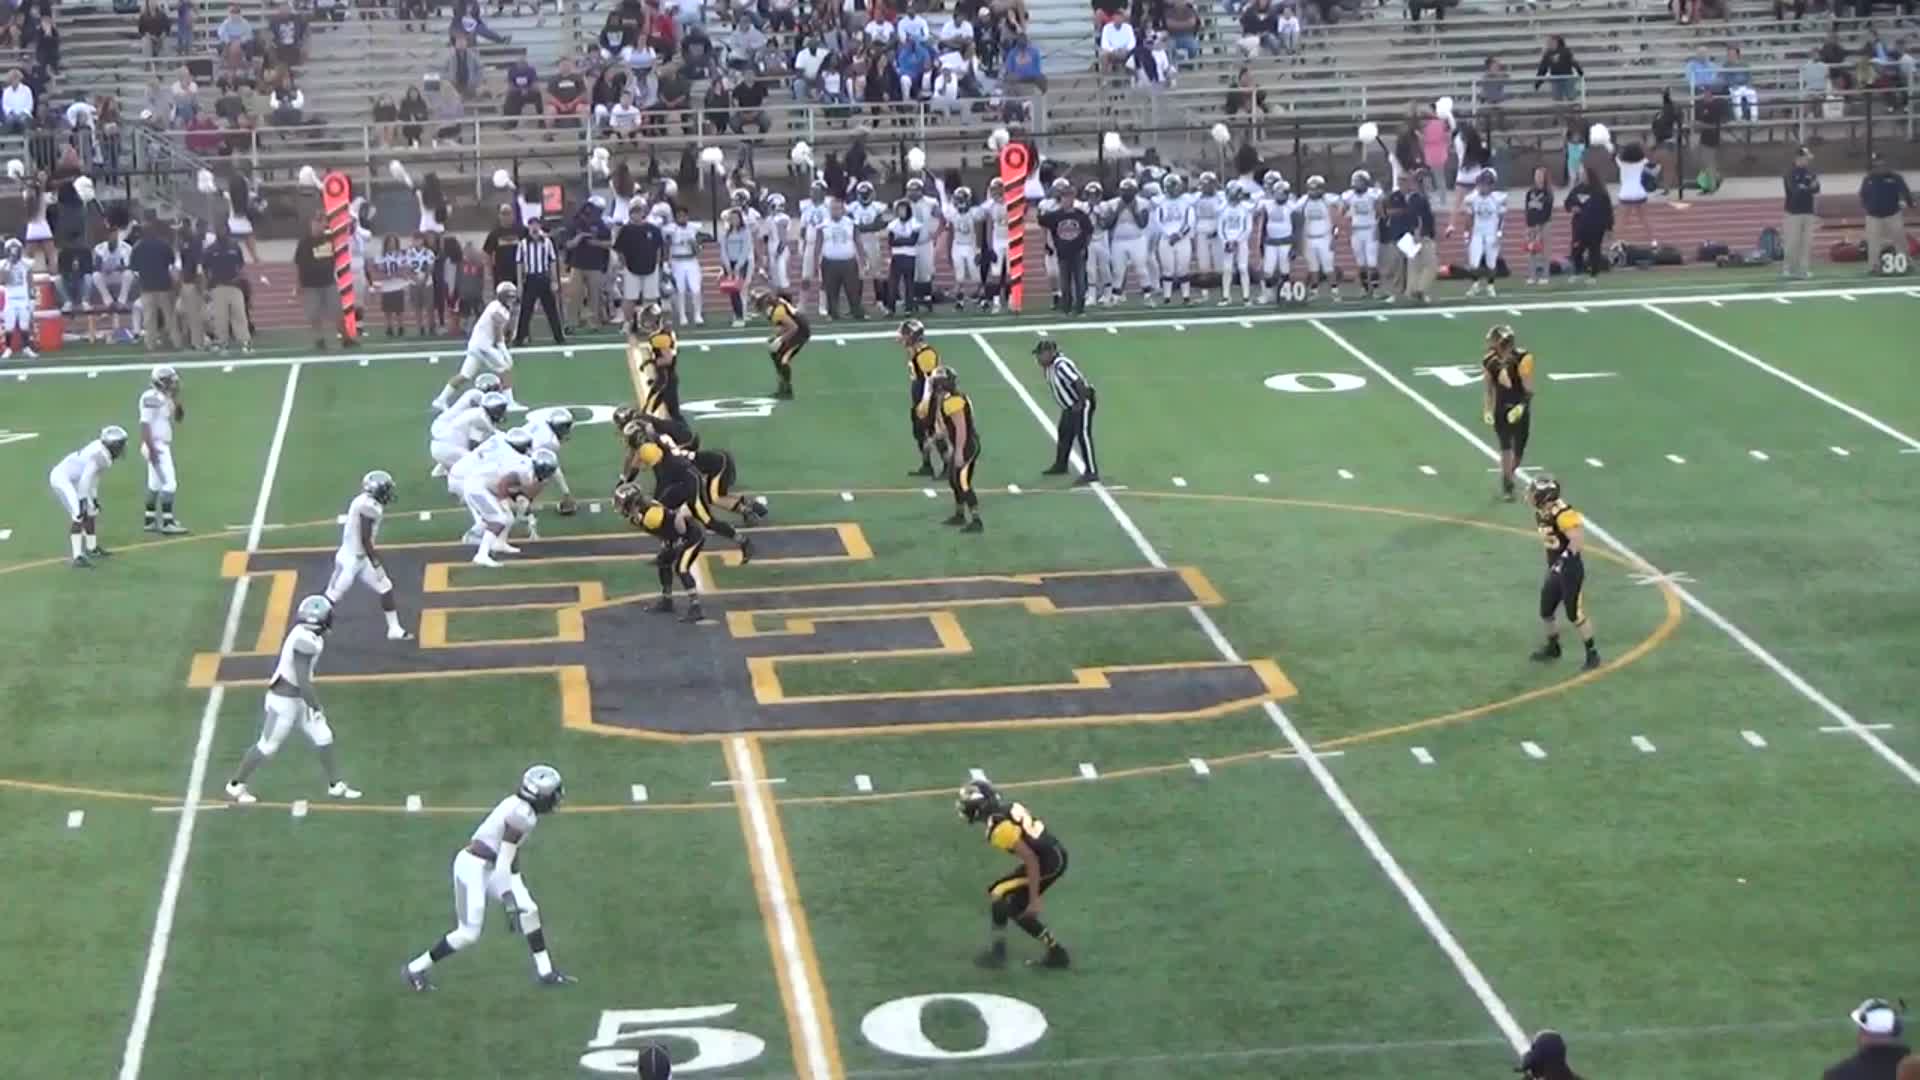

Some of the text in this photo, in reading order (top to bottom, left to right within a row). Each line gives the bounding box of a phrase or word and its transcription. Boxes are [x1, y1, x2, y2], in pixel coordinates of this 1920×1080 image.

[1881, 253, 1907, 273] 30
[1280, 281, 1306, 301] 40
[579, 992, 1049, 1074] 50
